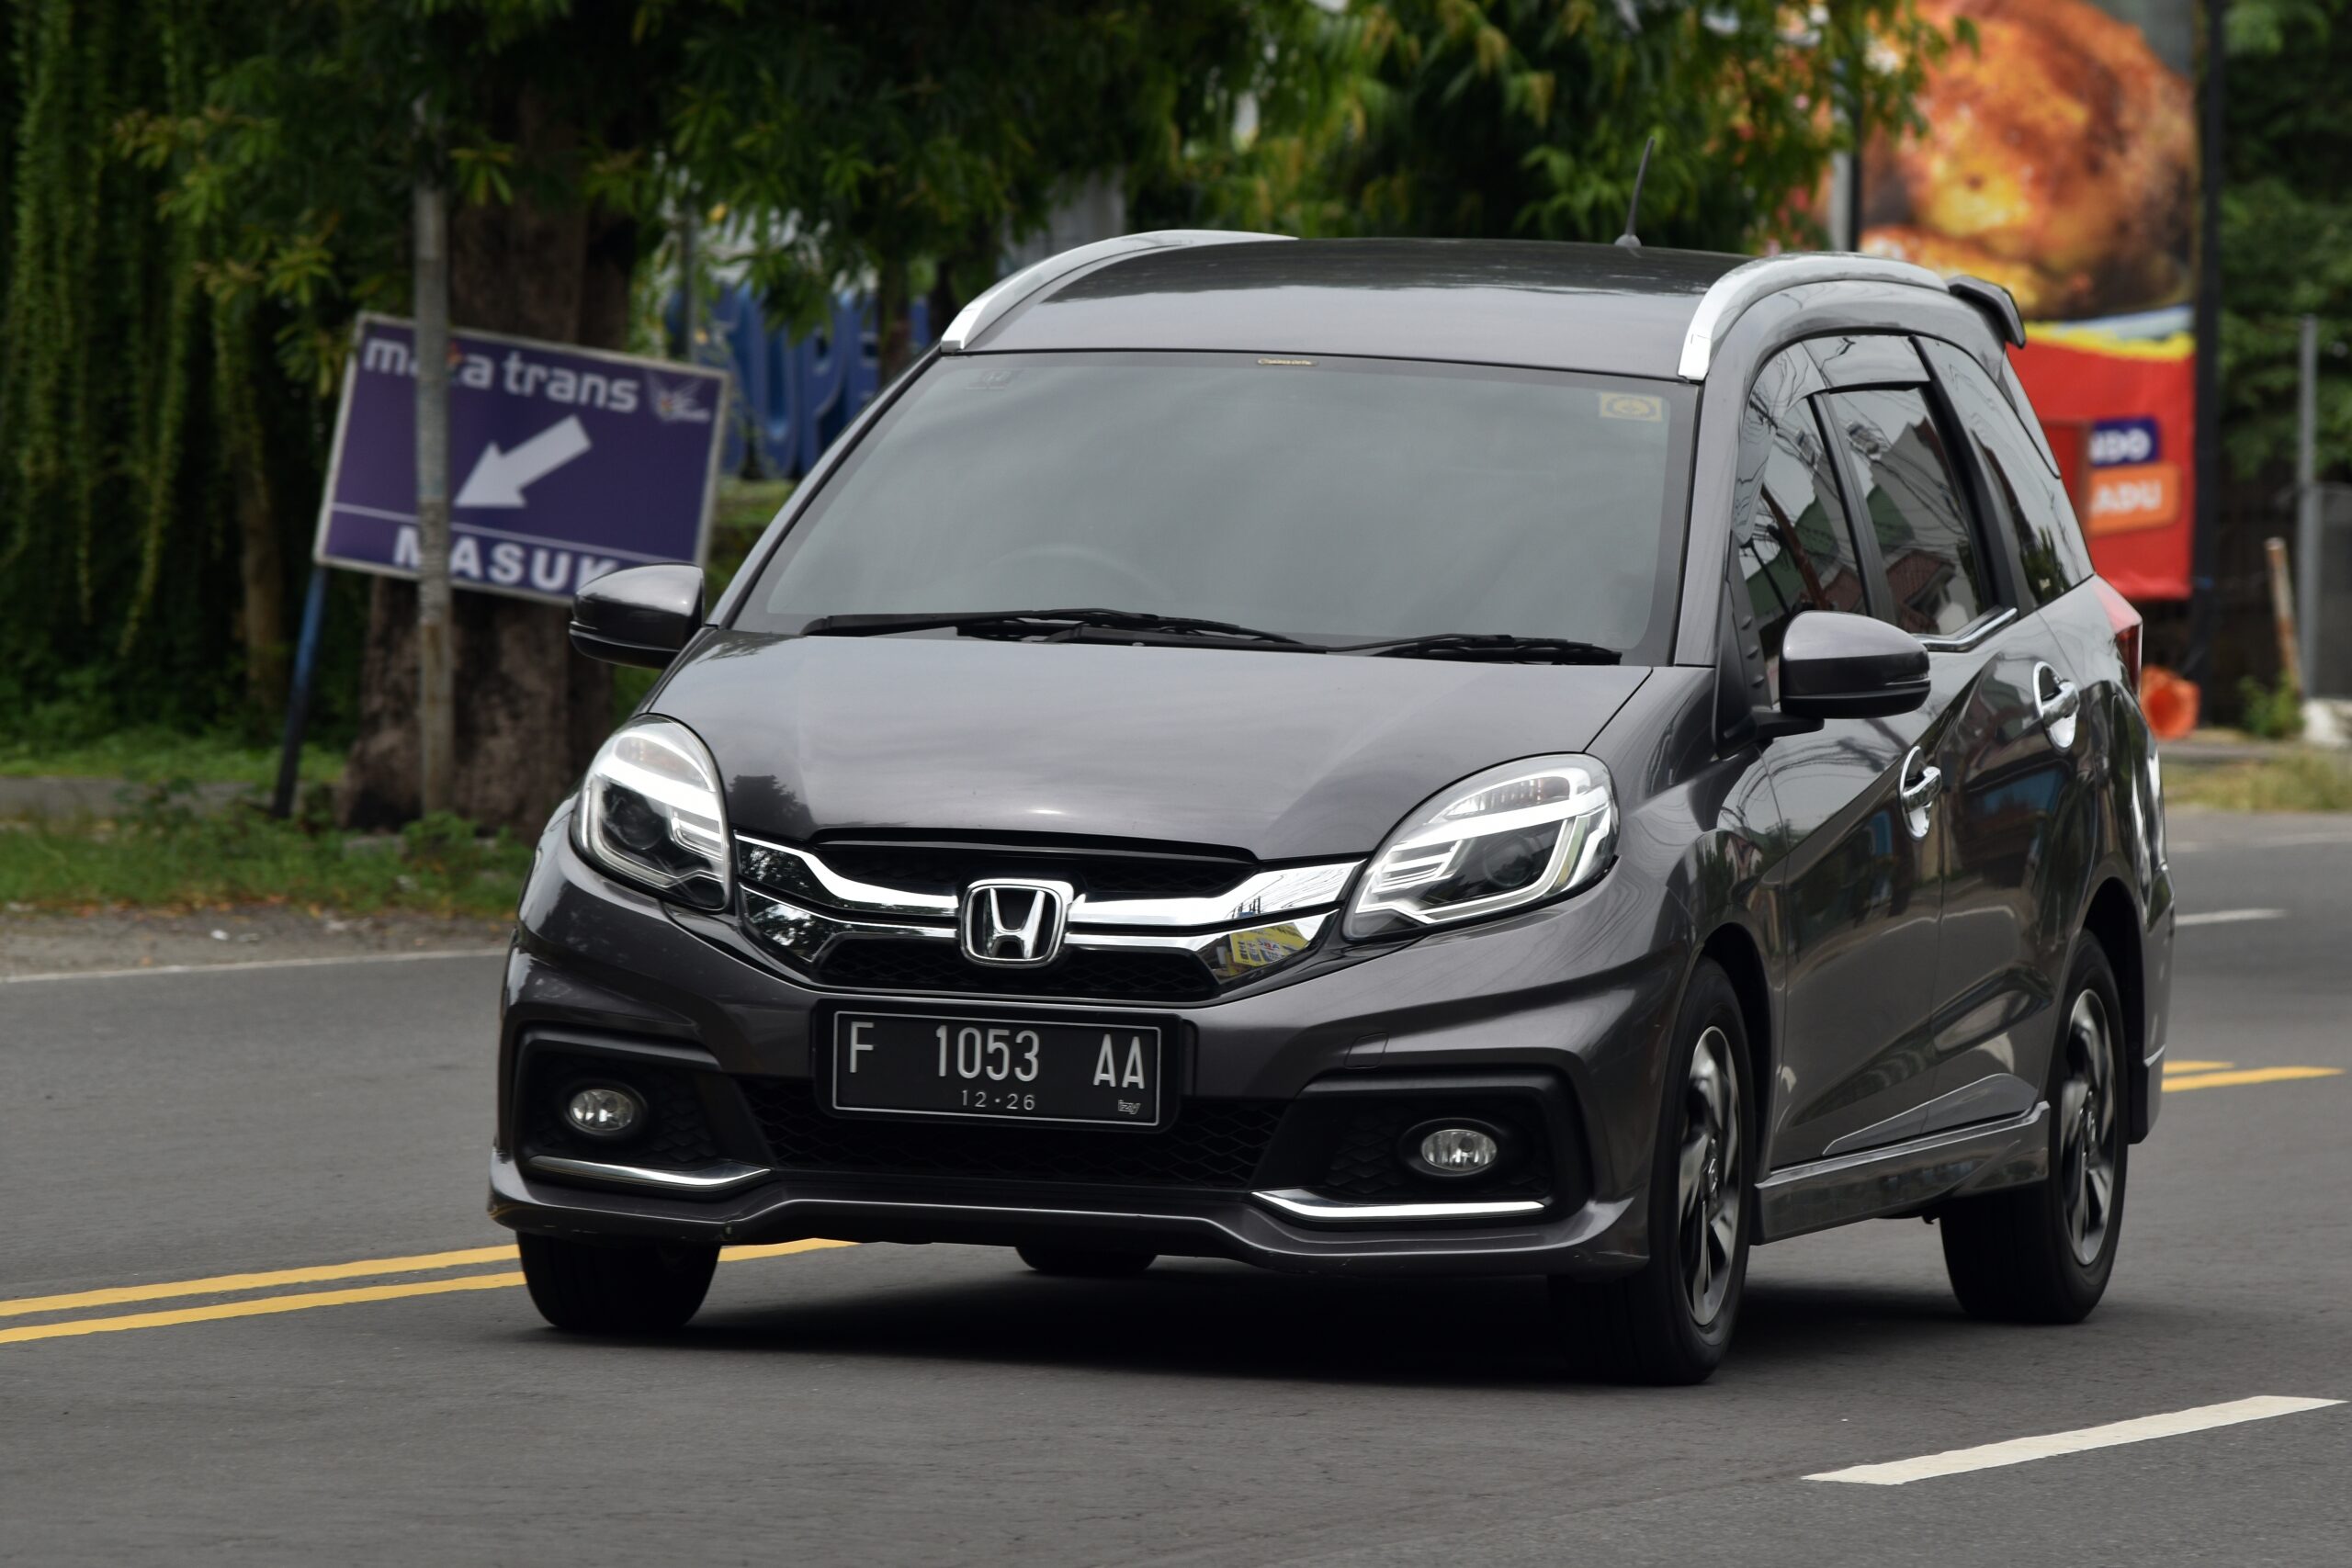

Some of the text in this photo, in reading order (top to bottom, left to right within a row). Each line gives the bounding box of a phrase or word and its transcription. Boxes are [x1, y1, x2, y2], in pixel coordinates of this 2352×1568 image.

[364, 337, 640, 414] ma trans
[849, 1021, 1146, 1089] F 1053 AA
